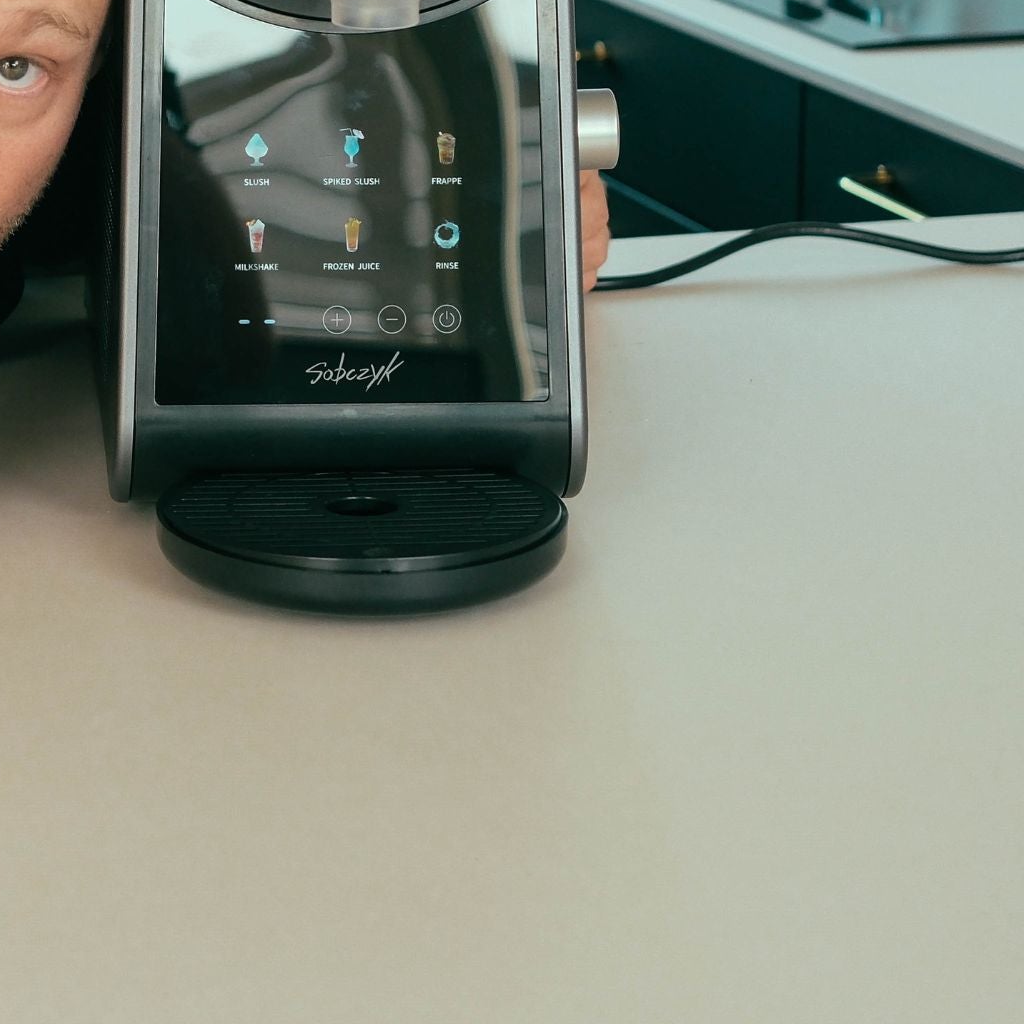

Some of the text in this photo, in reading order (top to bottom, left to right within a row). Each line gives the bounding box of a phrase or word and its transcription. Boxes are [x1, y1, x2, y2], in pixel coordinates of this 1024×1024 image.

[244, 178, 270, 186] SLUSH
[323, 178, 380, 186] SPIKED SLUSH
[431, 177, 463, 185] FRAPPE
[234, 263, 279, 271] MILKSHAKE
[323, 262, 381, 270] FROZEN JUICE
[435, 262, 459, 270] RINSE
